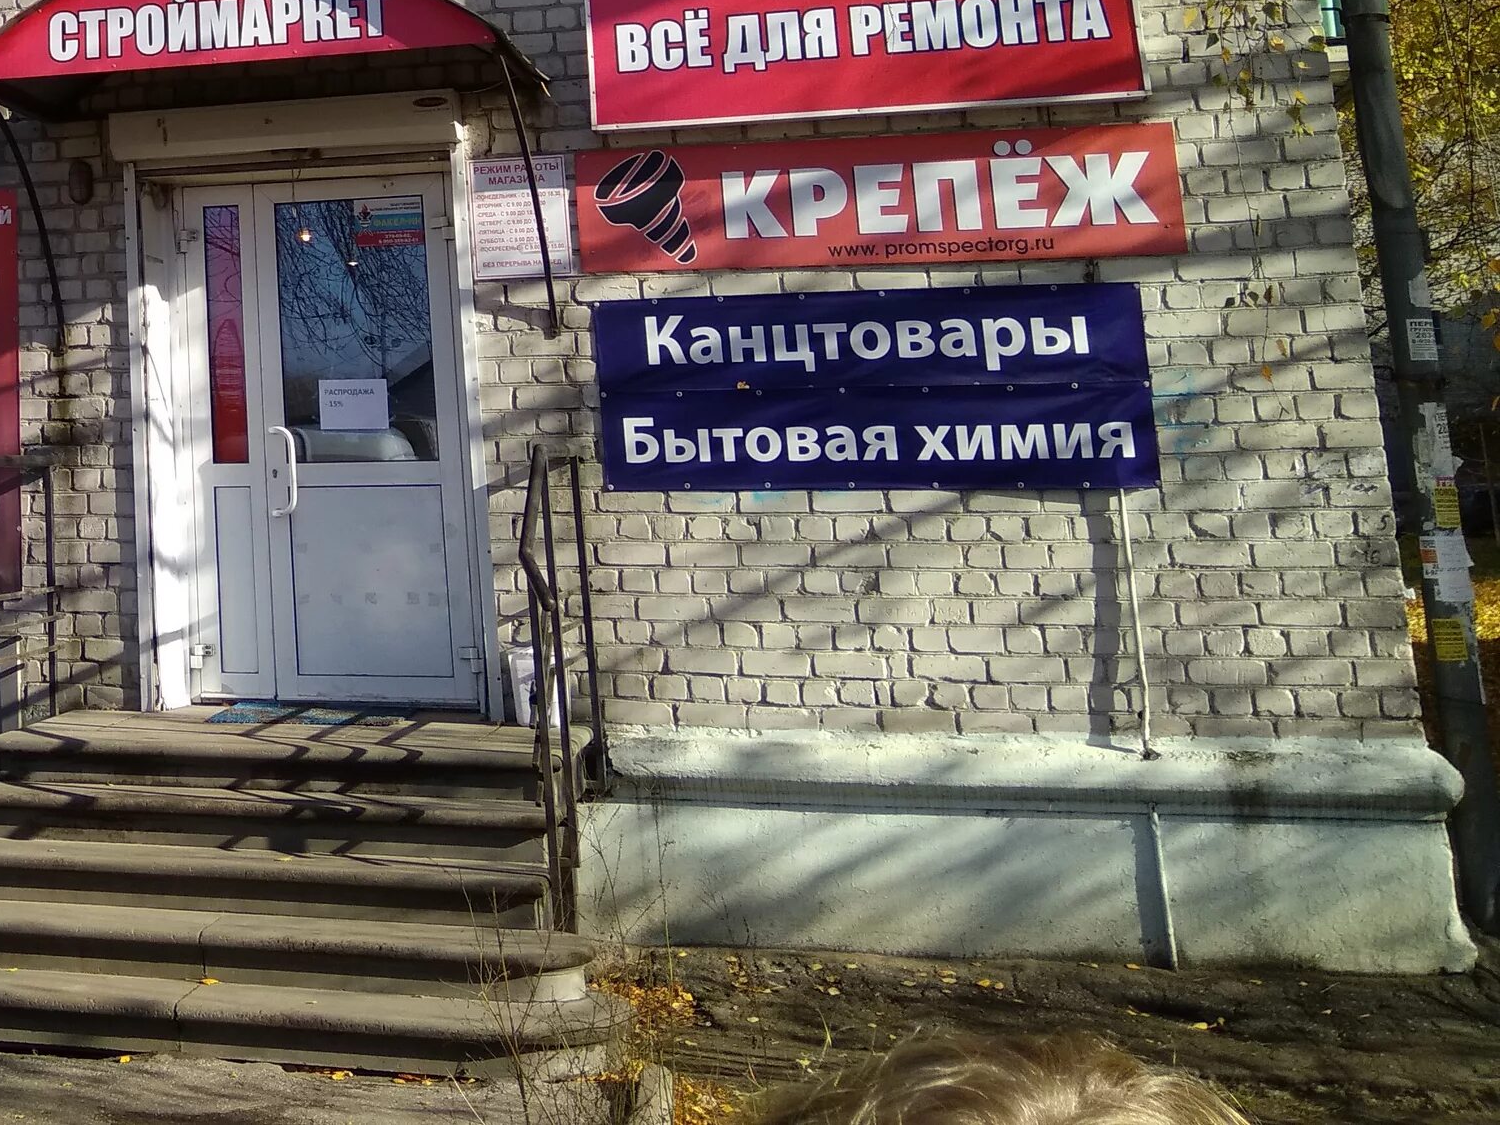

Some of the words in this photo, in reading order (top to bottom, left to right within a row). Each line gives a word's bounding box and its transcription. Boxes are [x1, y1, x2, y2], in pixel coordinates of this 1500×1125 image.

[616, 8, 712, 73] ВСЁ
[723, 6, 837, 73] ДЛЯ
[473, 165, 511, 175] РЕЖИМ
[514, 162, 559, 172] РАОТЫ
[721, 139, 1160, 240] КРЕПЁЖ
[885, 236, 1055, 258] promspectorg.ru
[644, 315, 1089, 372] Канцтовары
[324, 388, 374, 396] РАСПРОДАЖА
[622, 417, 900, 464] Бытовая
[914, 421, 1136, 462] химия
